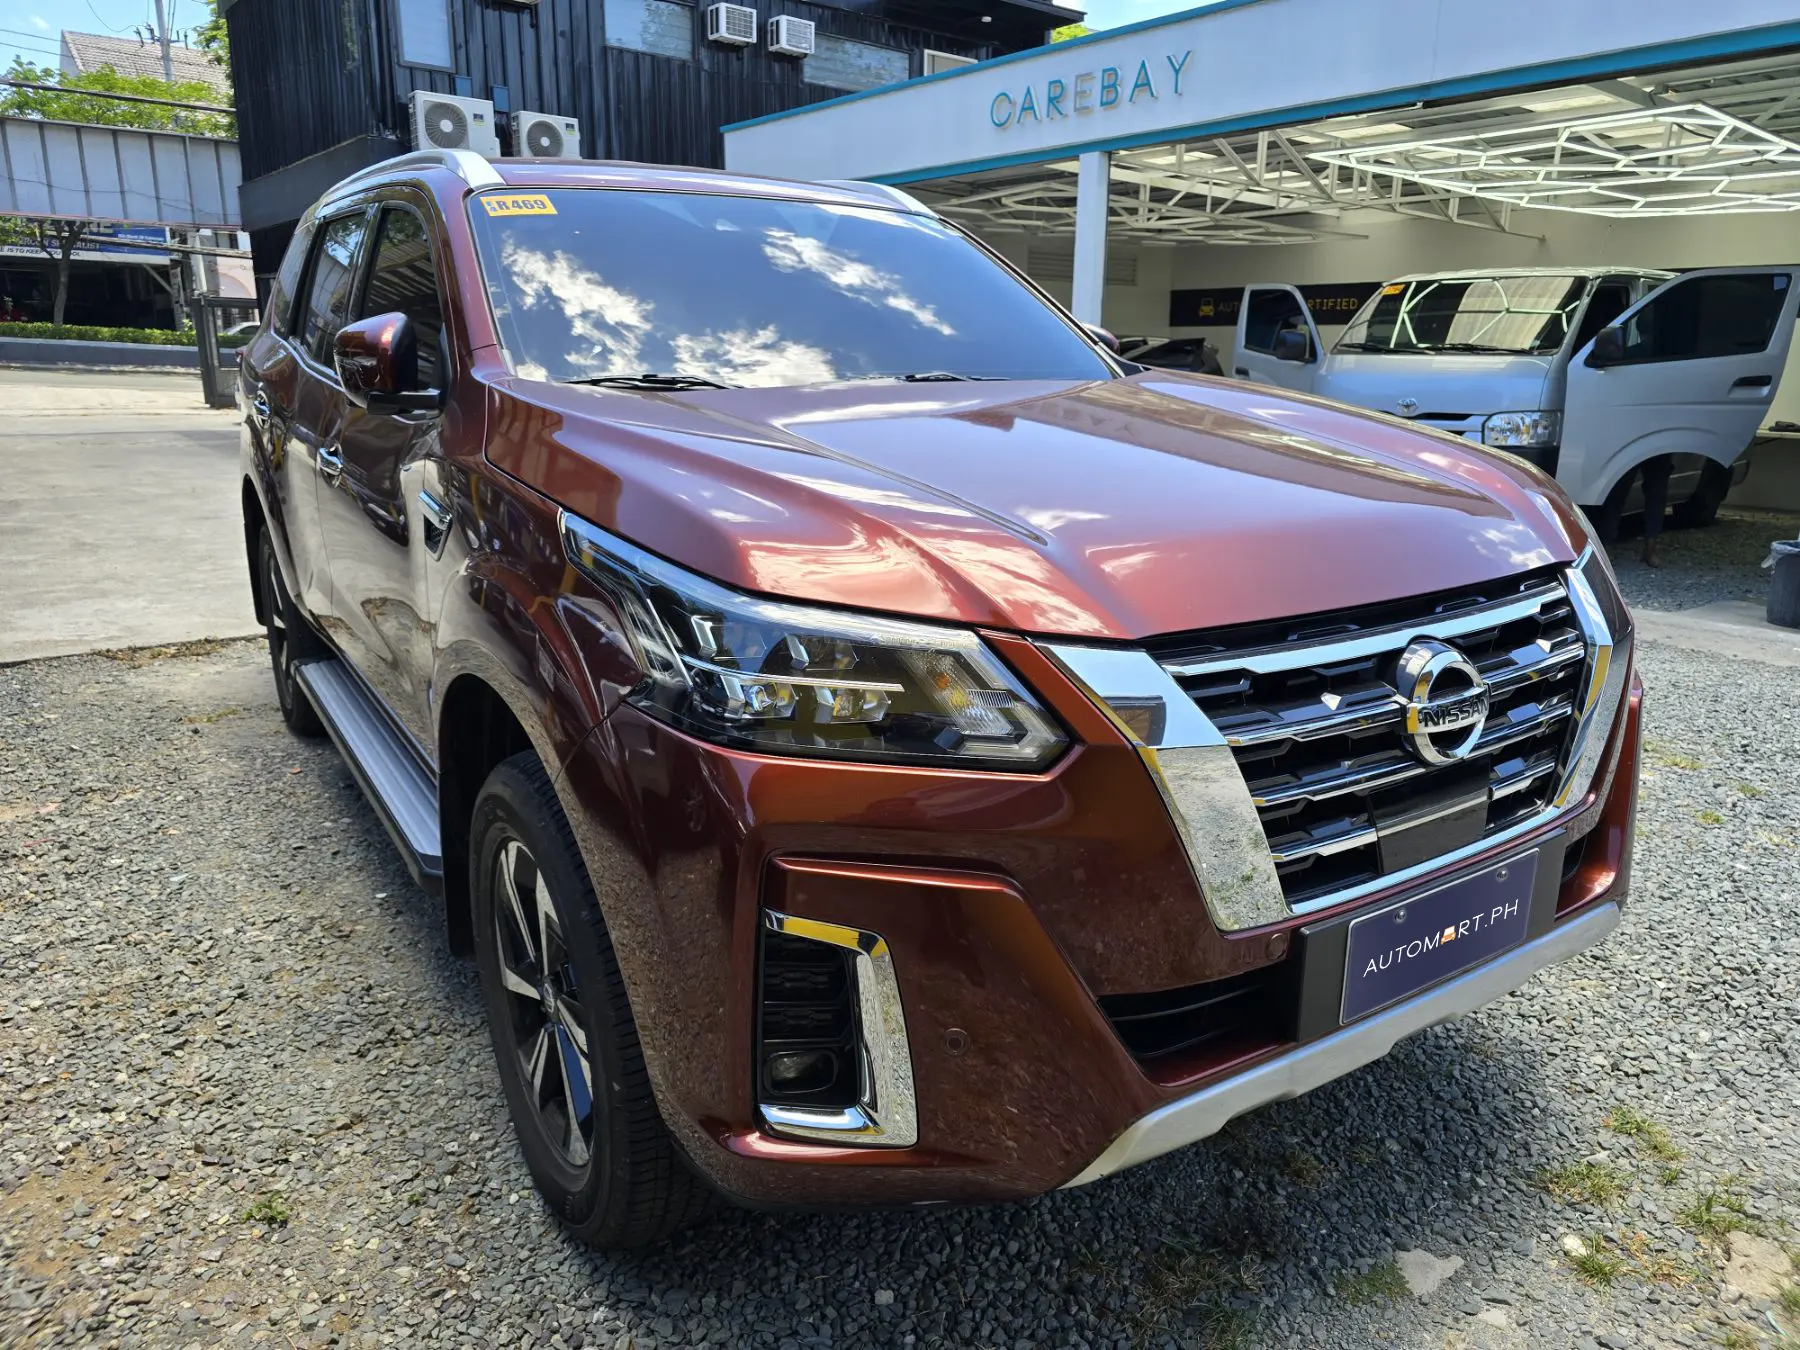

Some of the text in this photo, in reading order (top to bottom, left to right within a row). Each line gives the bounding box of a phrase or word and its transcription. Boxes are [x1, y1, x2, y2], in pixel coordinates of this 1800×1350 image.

[990, 51, 1193, 129] CAREBAY
[1307, 298, 1359, 311] RTIFIED
[1423, 694, 1489, 728] NISSAN
